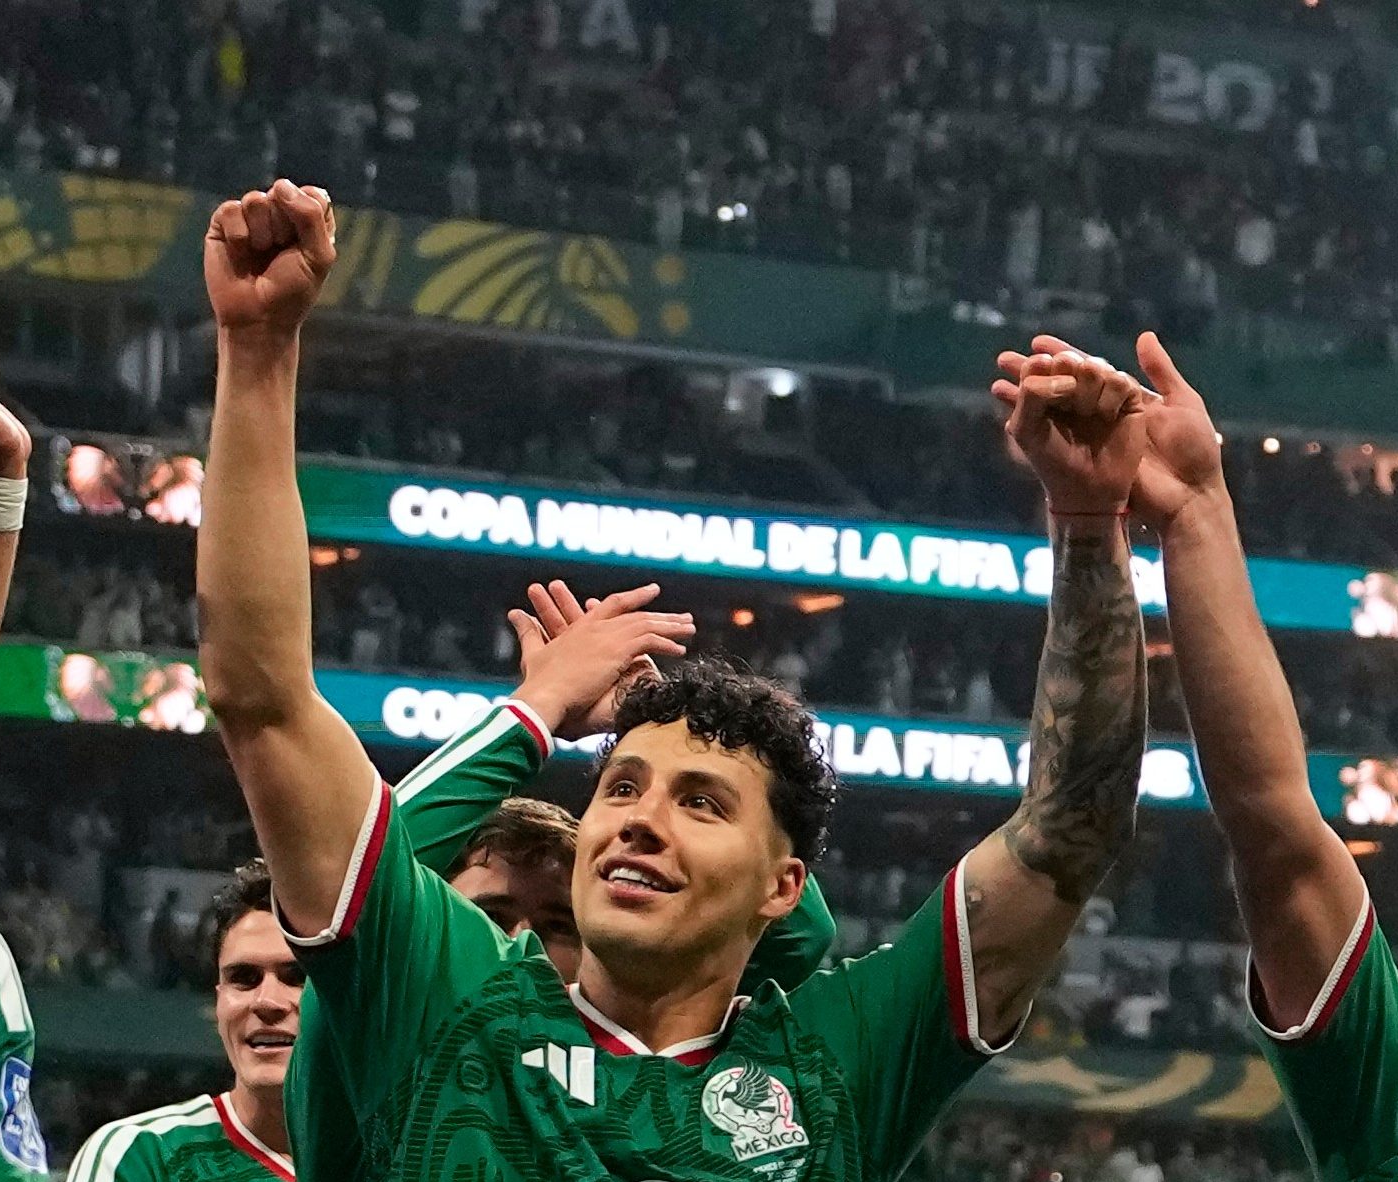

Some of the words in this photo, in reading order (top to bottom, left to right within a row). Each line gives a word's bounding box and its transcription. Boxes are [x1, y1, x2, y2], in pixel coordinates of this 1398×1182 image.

[389, 484, 534, 547] COPA
[536, 499, 766, 569] MUNDIAL
[767, 521, 839, 575] DE
[839, 529, 909, 582] LA
[909, 535, 1020, 593] FIFA
[833, 724, 901, 777] LA
[904, 730, 1014, 786] FIFA
[735, 1130, 805, 1158] MÉXICO
